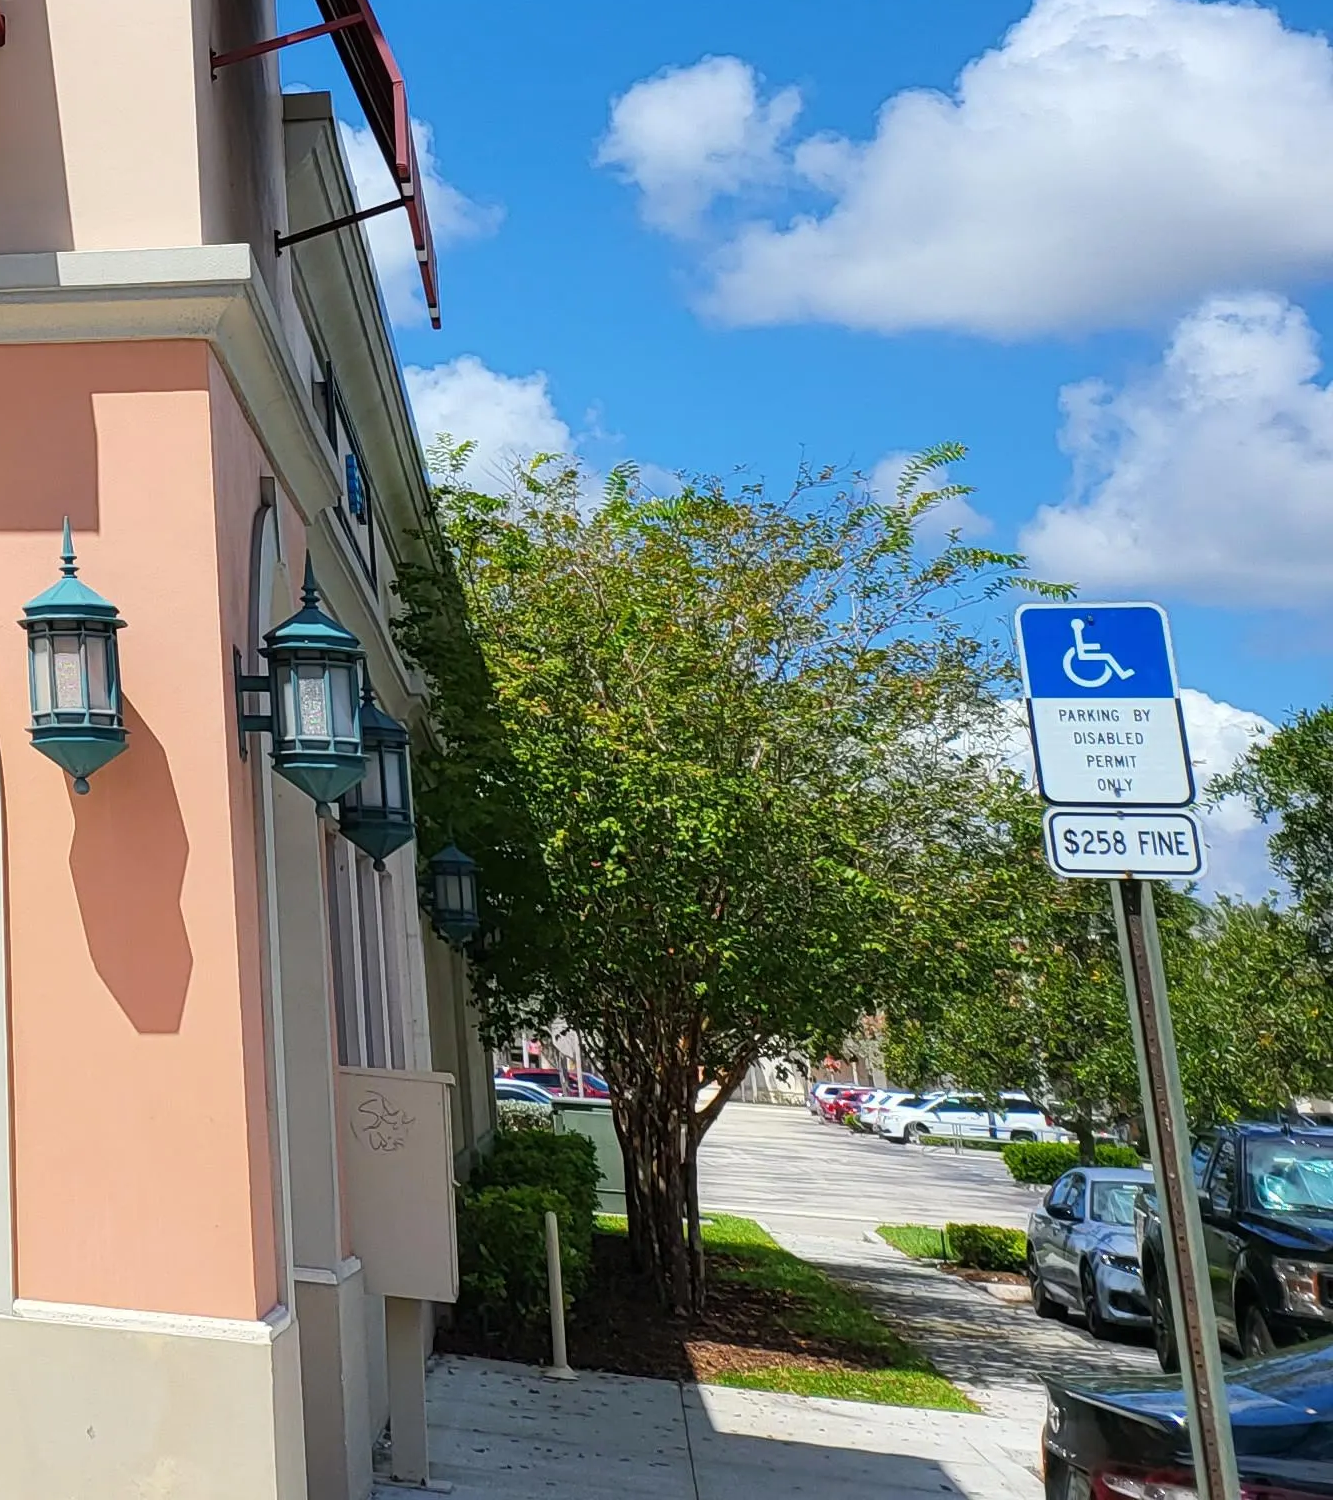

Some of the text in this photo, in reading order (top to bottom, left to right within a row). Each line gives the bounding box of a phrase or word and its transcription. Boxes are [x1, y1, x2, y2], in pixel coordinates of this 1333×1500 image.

[1058, 708, 1151, 722] PARKING BY
[1074, 732, 1144, 745] DISABLED
[1086, 755, 1137, 768] PERMIT
[1097, 778, 1133, 792] ONLY
[1063, 828, 1190, 858] $258 FINE
